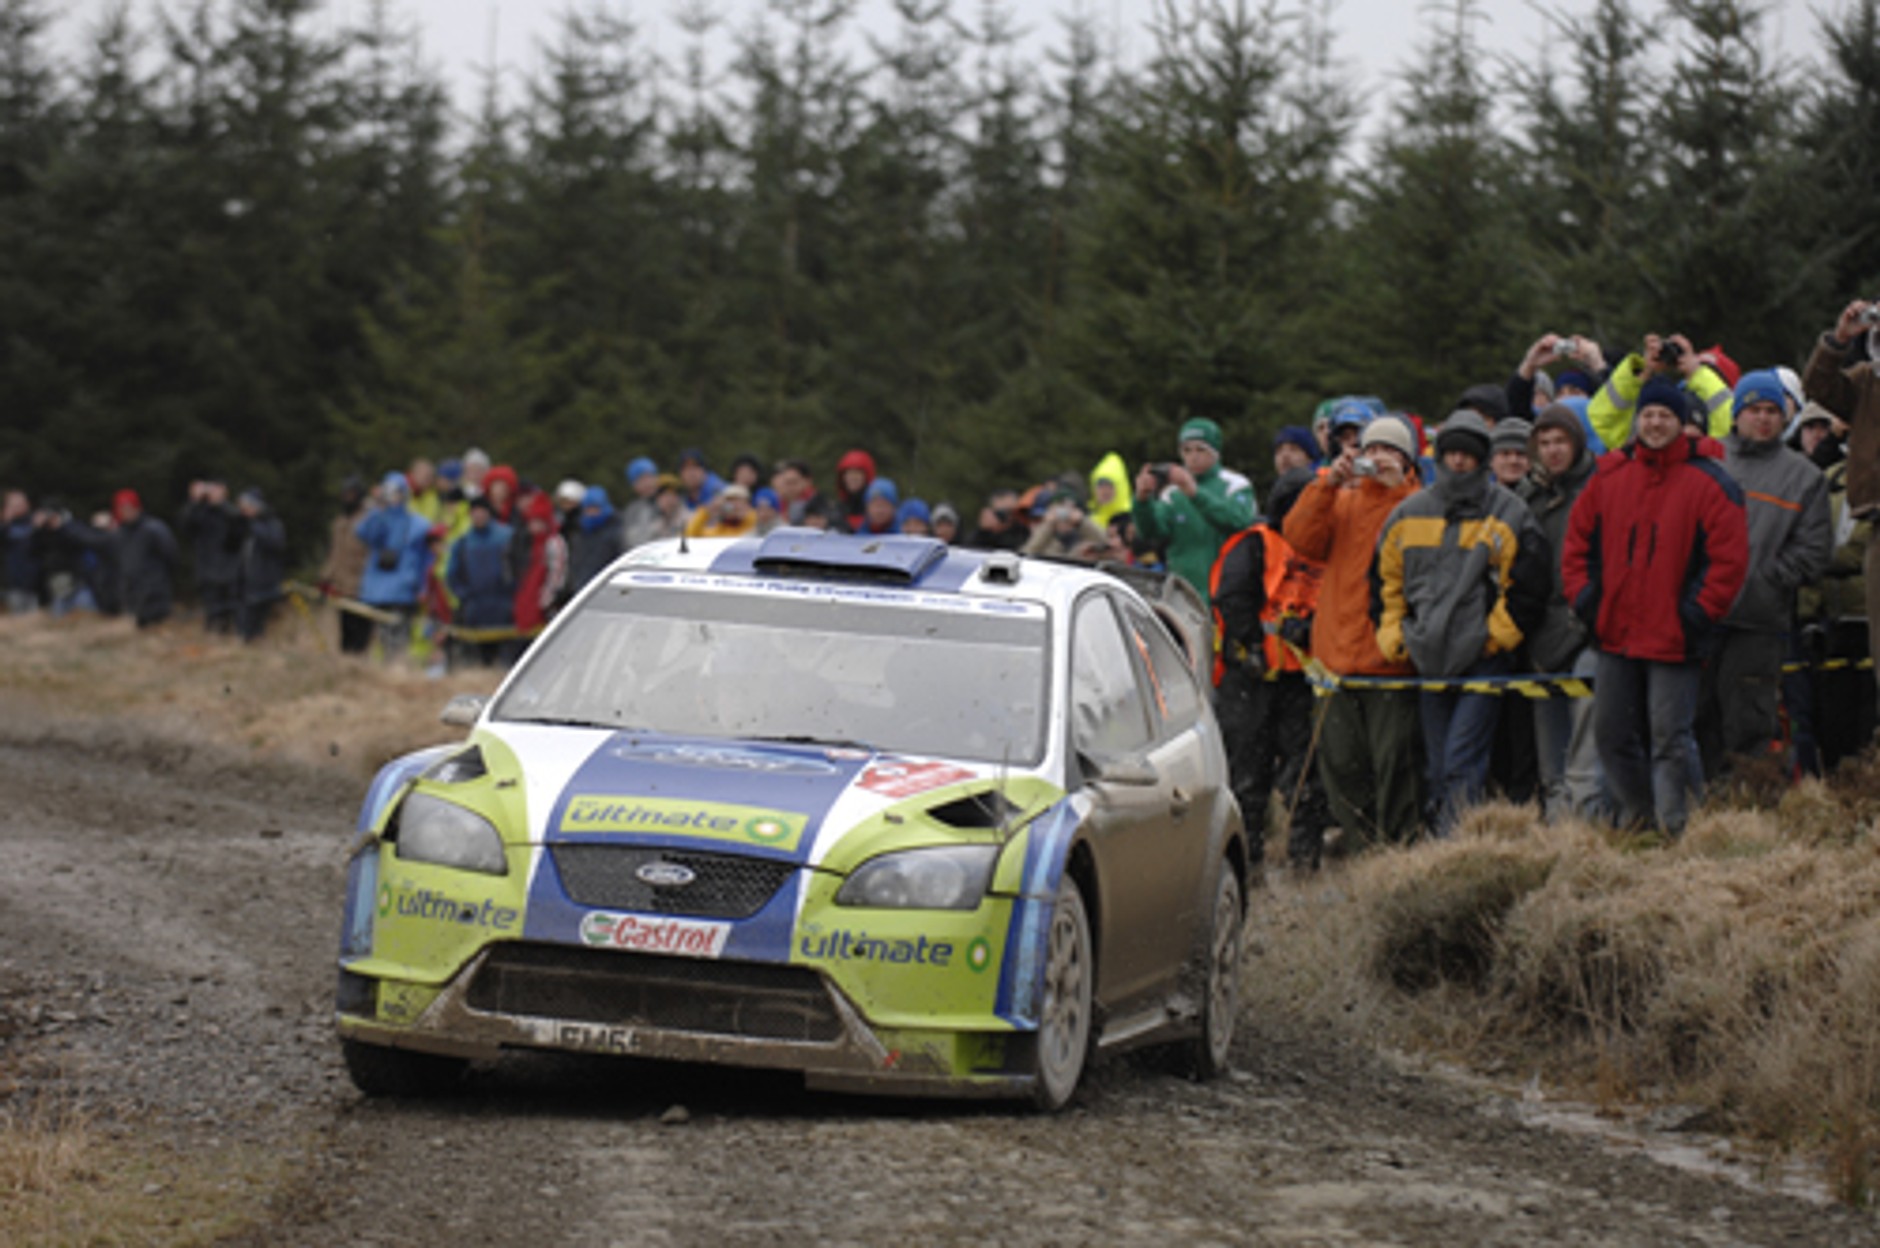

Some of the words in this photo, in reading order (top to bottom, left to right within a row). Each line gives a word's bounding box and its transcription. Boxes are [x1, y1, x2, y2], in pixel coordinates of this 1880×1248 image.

[571, 803, 738, 832] ultimate
[398, 889, 517, 930] ultimate
[615, 915, 719, 954] Castrol
[802, 929, 954, 967] ultimate
